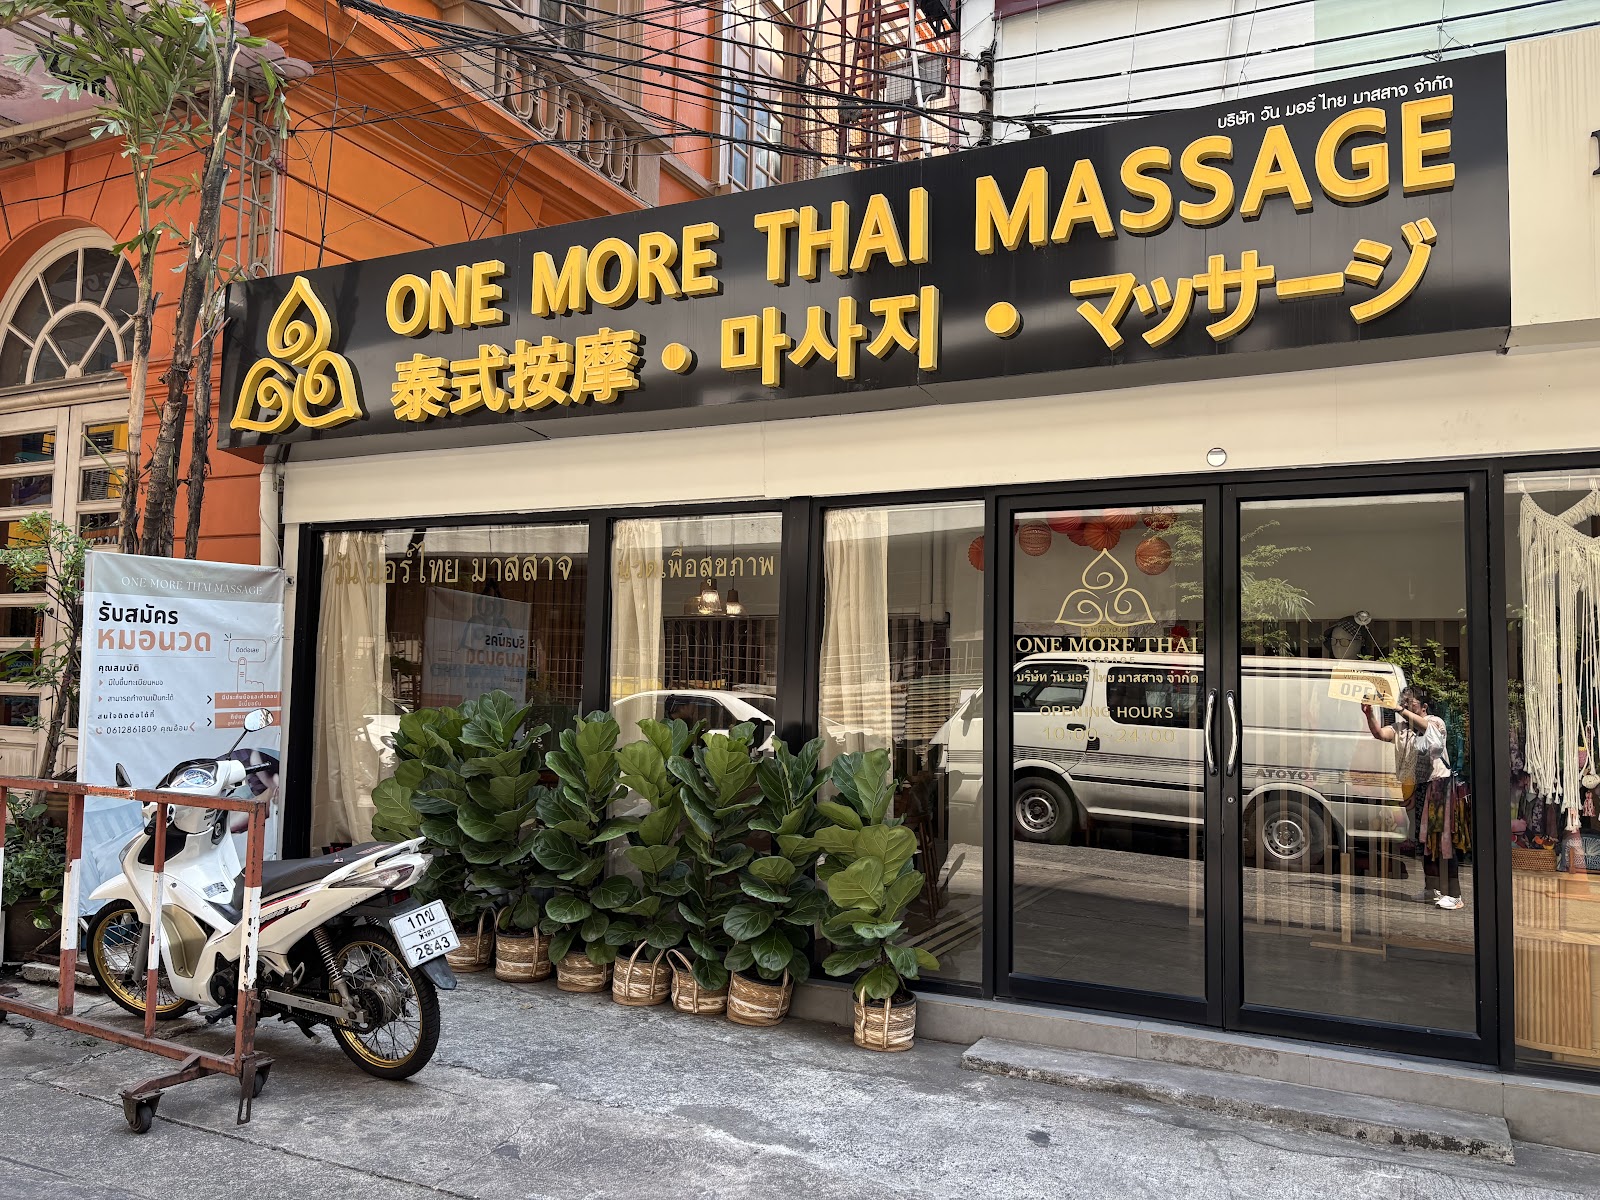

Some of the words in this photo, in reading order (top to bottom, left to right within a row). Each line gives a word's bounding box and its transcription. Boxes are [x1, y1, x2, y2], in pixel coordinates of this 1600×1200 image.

[1217, 109, 1255, 129] บริษัท
[1260, 105, 1280, 120] วัน
[1286, 96, 1317, 116] มอร์
[1318, 92, 1347, 111] ไทย
[1353, 84, 1409, 105] มาสสาจ
[1414, 74, 1453, 95] จำกัด
[386, 259, 507, 337] ONE
[531, 222, 722, 317] MORE
[754, 187, 931, 285] THAI
[975, 94, 1457, 254] MASSAGE
[1069, 216, 1439, 350] マッサージ
[720, 285, 940, 387] 마사지
[391, 326, 642, 422] 泰式按摩
[471, 553, 574, 584] มาสสาจ
[121, 576, 147, 588] ONE
[150, 578, 183, 590] MORE
[186, 580, 213, 592] THAI
[213, 583, 263, 595] MASSAGE
[98, 600, 179, 625] รับสมัคร
[97, 628, 212, 652] หมอนวด
[1016, 637, 1063, 653] ONE
[1068, 637, 1136, 653] MORE
[1139, 637, 1199, 654] THAI
[98, 663, 140, 675] คุณสมบัติ
[1077, 656, 1136, 664] MASSAGE
[1016, 669, 1047, 682] บริษัท
[1051, 669, 1065, 683] วัน
[1067, 668, 1090, 683] มอร์
[1118, 672, 1164, 684] มาสสาจ
[1167, 669, 1199, 684] จำกัด
[1040, 705, 1111, 718] OPENING
[1117, 705, 1174, 719] HOURS
[106, 725, 158, 735] 0612861809
[416, 937, 451, 960] 2843
